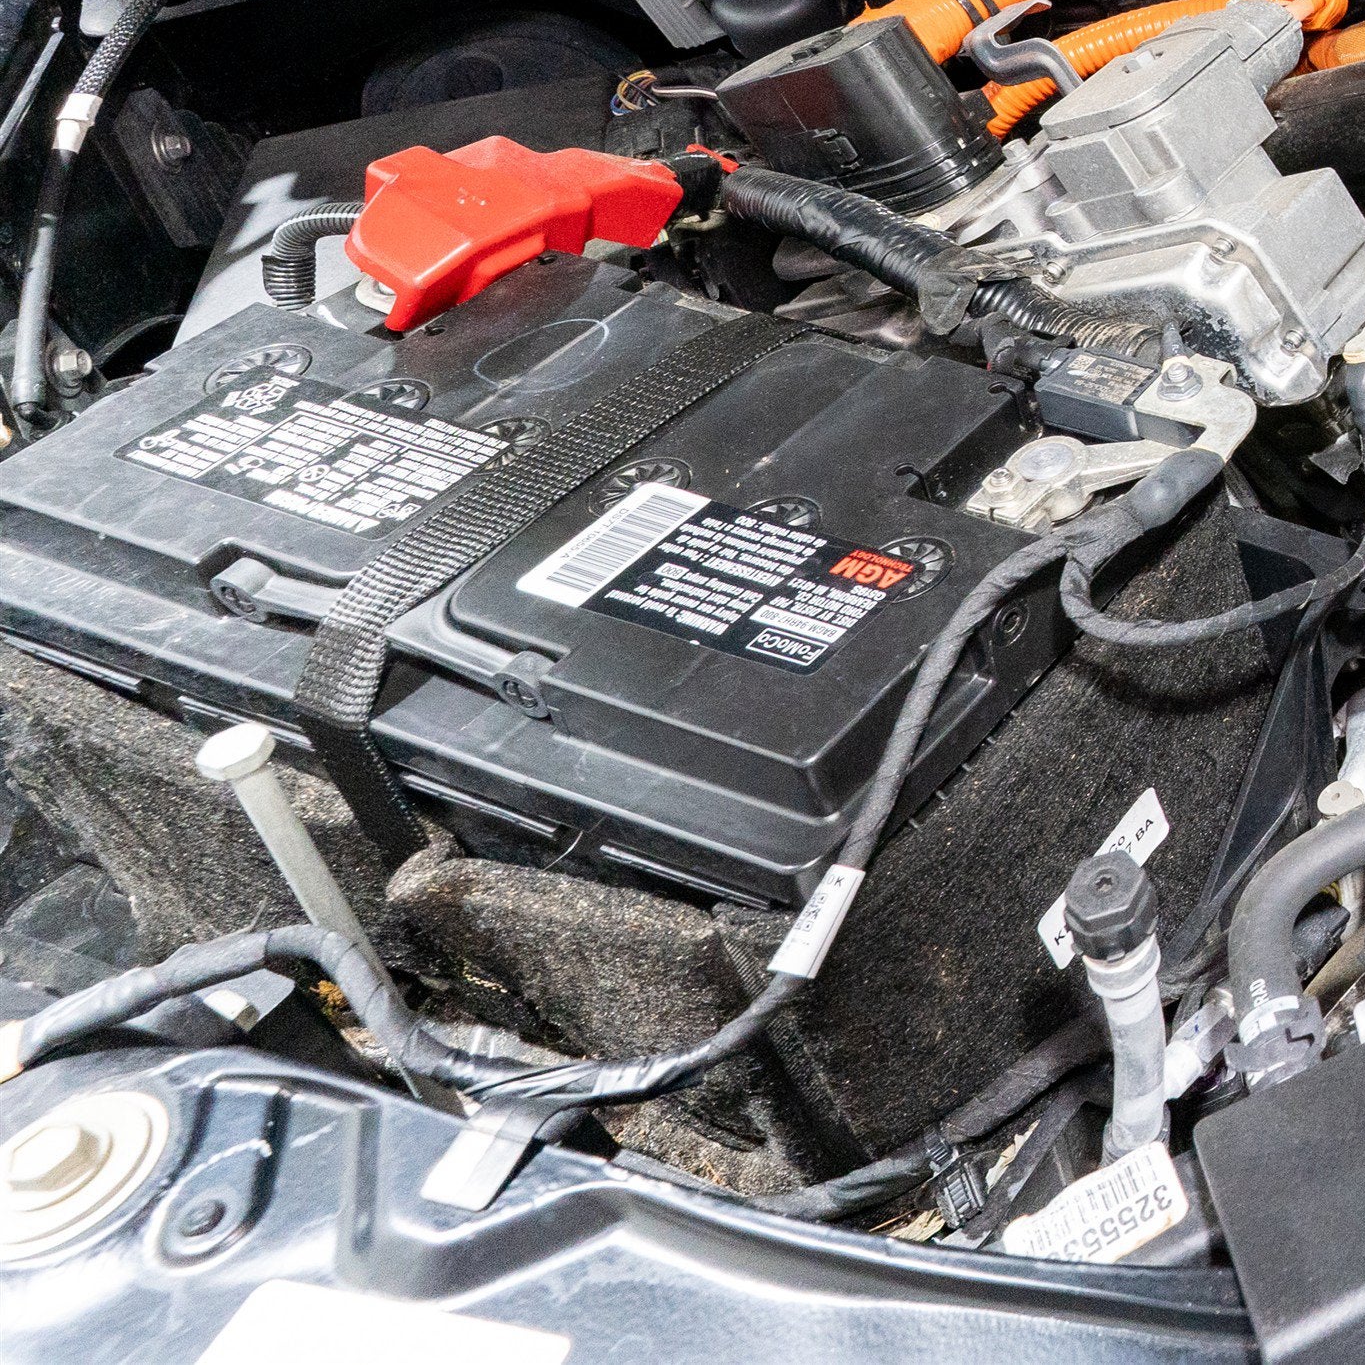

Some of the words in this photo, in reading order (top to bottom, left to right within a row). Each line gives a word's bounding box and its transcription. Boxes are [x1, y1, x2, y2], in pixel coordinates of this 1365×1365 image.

[659, 564, 684, 577] 800
[848, 547, 916, 573] TECHNOLOGY
[699, 555, 786, 587] AVERTISSEMENT
[825, 555, 907, 592] AGM
[790, 590, 813, 602] CO.
[806, 594, 844, 611] MOTOR
[815, 608, 836, 621] BY
[837, 603, 868, 619] FORD
[669, 609, 732, 635] WARNING:
[752, 632, 822, 660] FoMoCo
